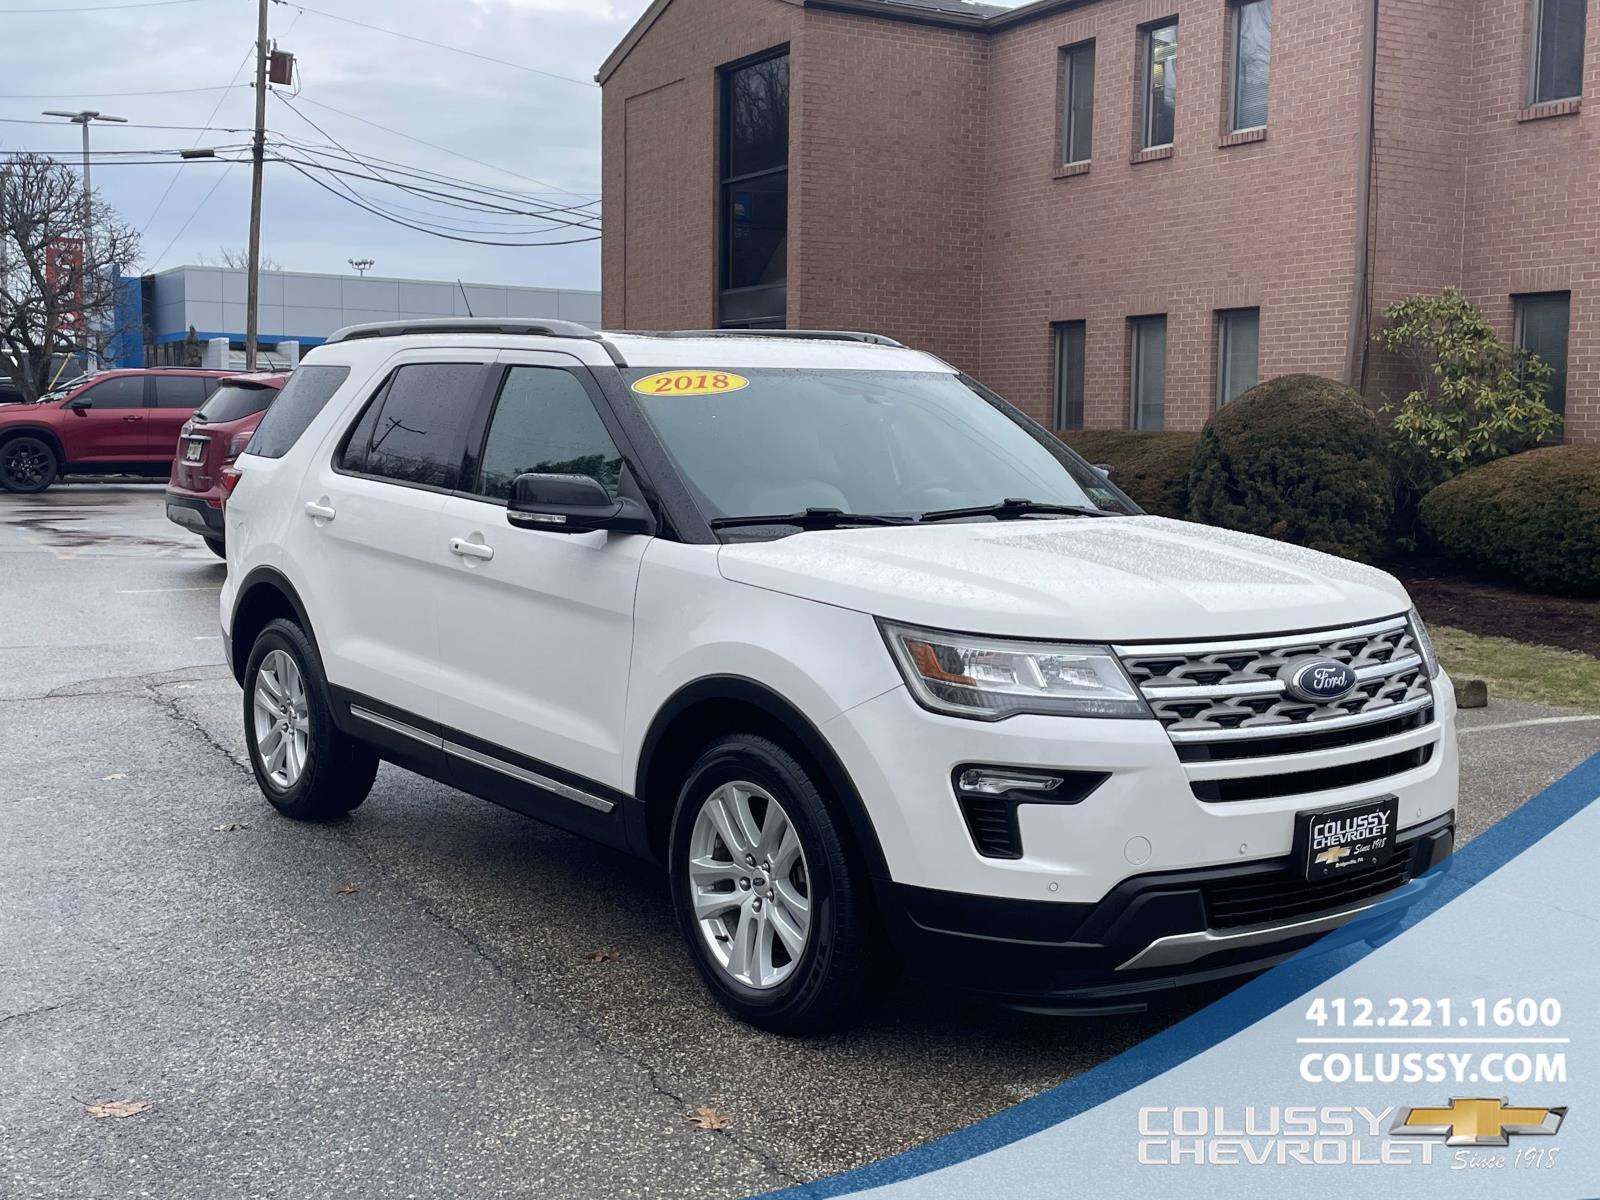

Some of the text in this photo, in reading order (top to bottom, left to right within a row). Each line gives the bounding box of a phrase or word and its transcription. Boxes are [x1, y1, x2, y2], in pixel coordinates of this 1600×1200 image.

[655, 374, 730, 392] 2018
[1313, 667, 1348, 689] Ford
[1313, 810, 1391, 839] COLUSSY
[1313, 823, 1390, 850] CHEVROLET
